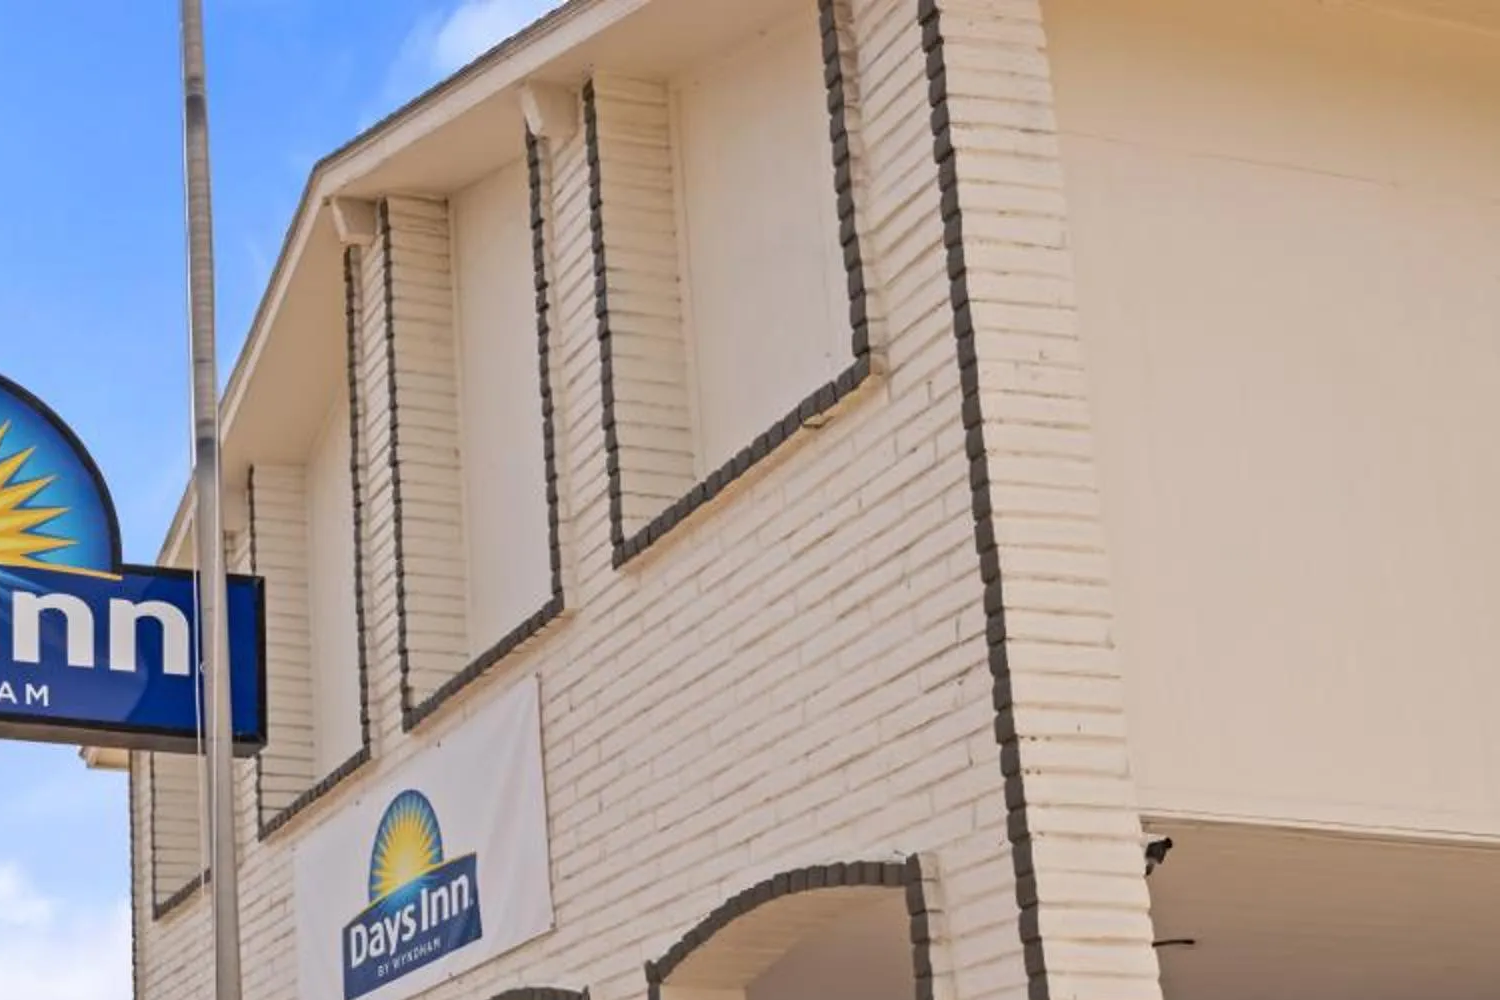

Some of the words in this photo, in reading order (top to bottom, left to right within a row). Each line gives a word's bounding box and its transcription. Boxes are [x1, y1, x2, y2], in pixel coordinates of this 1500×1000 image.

[350, 903, 417, 969] Days
[420, 873, 470, 933] Inn
[377, 963, 389, 977] BY
[393, 937, 441, 970] WYNDHAM
